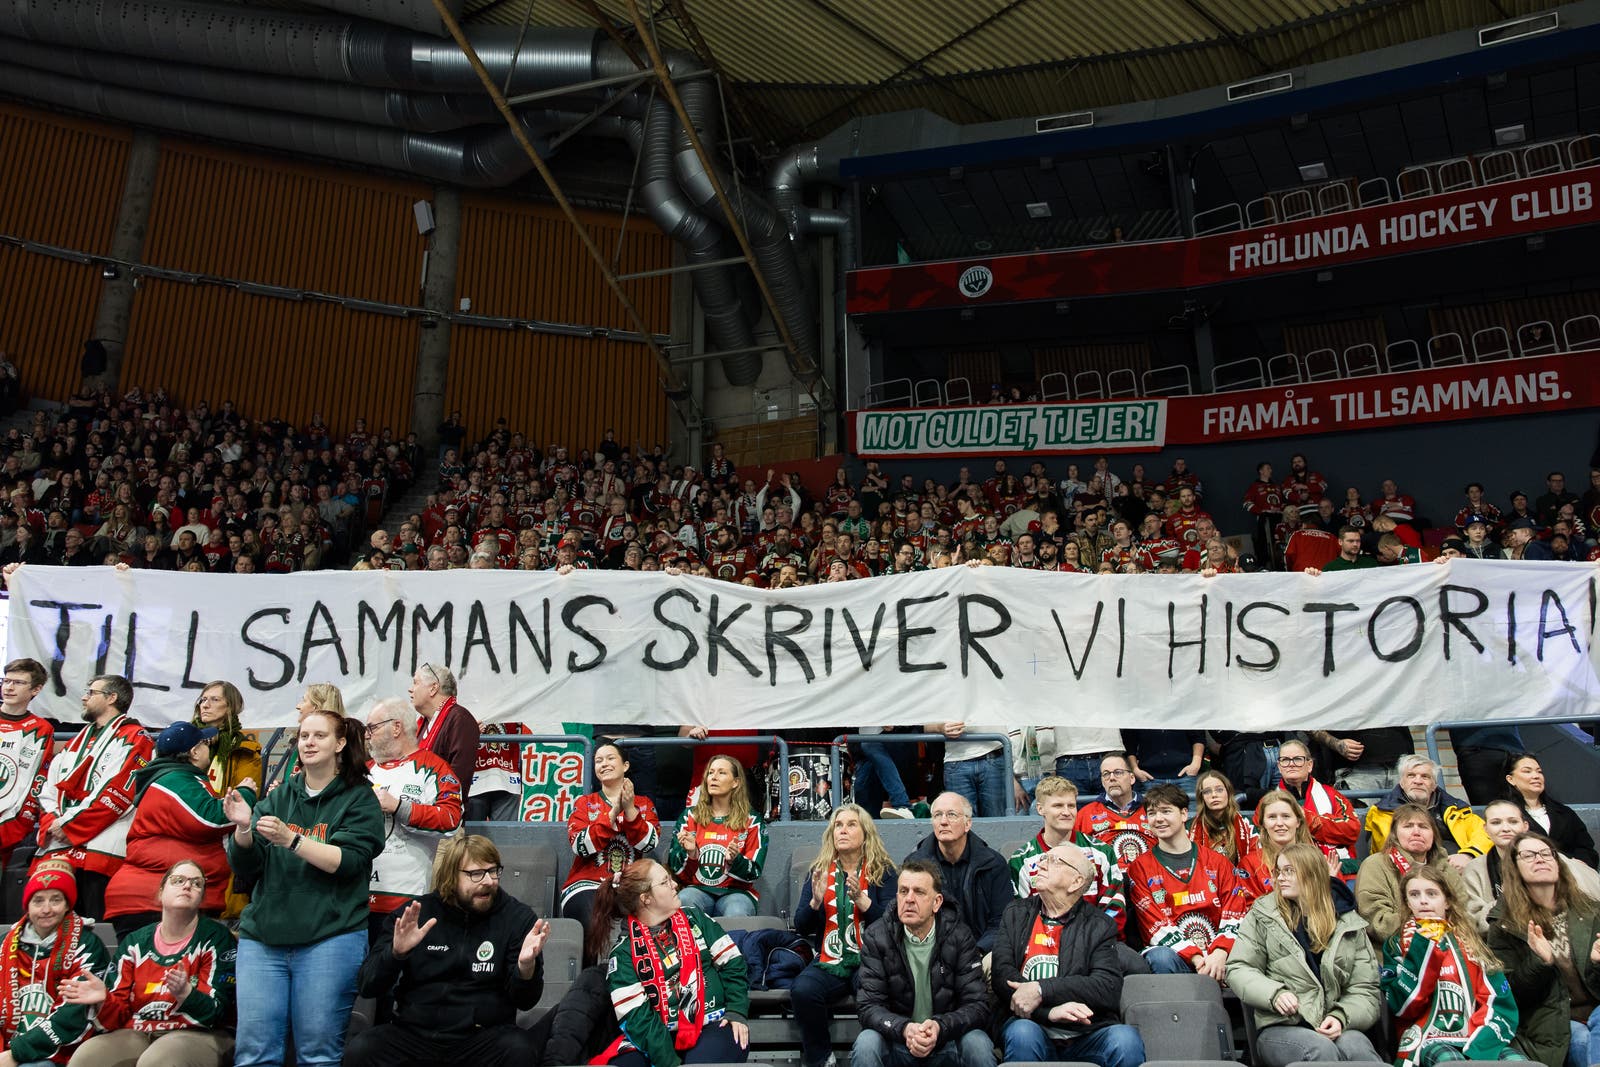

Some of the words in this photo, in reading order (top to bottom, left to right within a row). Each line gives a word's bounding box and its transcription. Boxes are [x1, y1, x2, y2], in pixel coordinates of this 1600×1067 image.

[1229, 223, 1370, 272] FRÖLUNDA
[1379, 198, 1499, 246] HOCKEY
[1510, 181, 1593, 222] CLUB
[863, 411, 924, 449] MOT
[925, 408, 1037, 450] GULDET,
[1042, 401, 1158, 445] TJEJER!
[1203, 389, 1320, 435] FRAMÅT.
[1330, 371, 1573, 422] TILLSAMMANS.
[642, 588, 1012, 687] SKRIVER
[1051, 597, 1125, 680] VI
[475, 756, 514, 770] tended
[522, 744, 583, 786] tra
[524, 788, 574, 822] at
[1181, 890, 1206, 905] input
